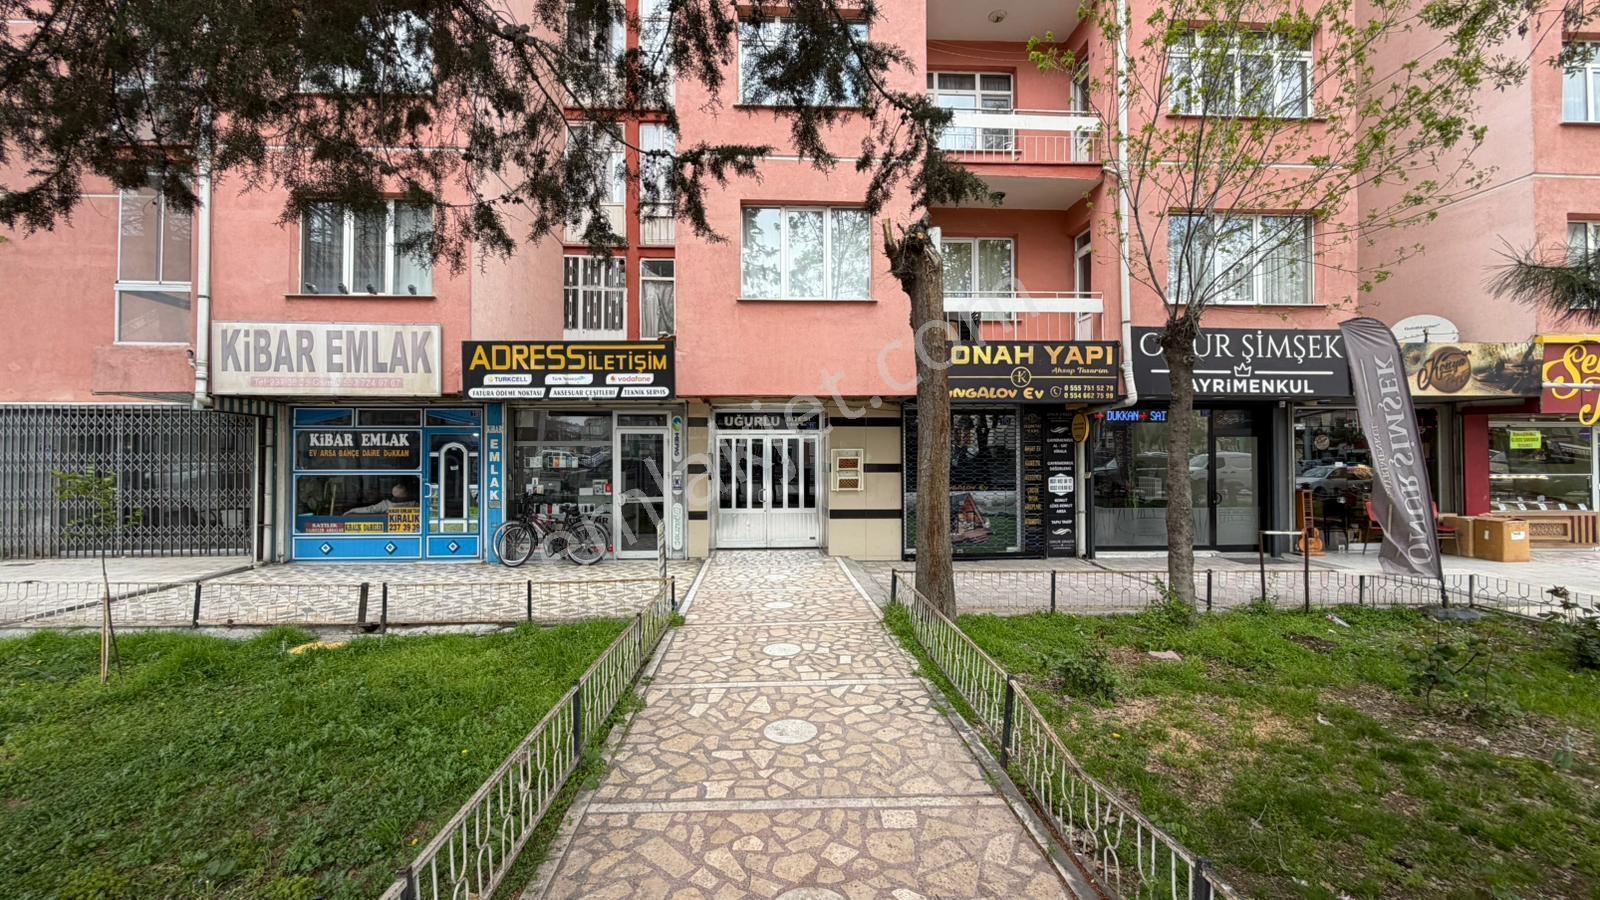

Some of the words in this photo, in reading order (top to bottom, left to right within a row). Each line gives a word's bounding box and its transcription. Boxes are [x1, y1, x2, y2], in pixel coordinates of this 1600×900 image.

[326, 330, 432, 374] EMLAK
[469, 344, 586, 371] ADRESS
[588, 351, 667, 373] İLETİŞİM
[1043, 345, 1113, 365] YAPI
[1139, 332, 1234, 358] OUR
[1241, 330, 1343, 364] ŞİMŞEK
[1543, 344, 1600, 400] Se
[724, 414, 780, 427] UĞURLU
[320, 449, 337, 457] ARSA
[361, 433, 410, 447] EMLAK
[489, 438, 501, 500] EMLAK
